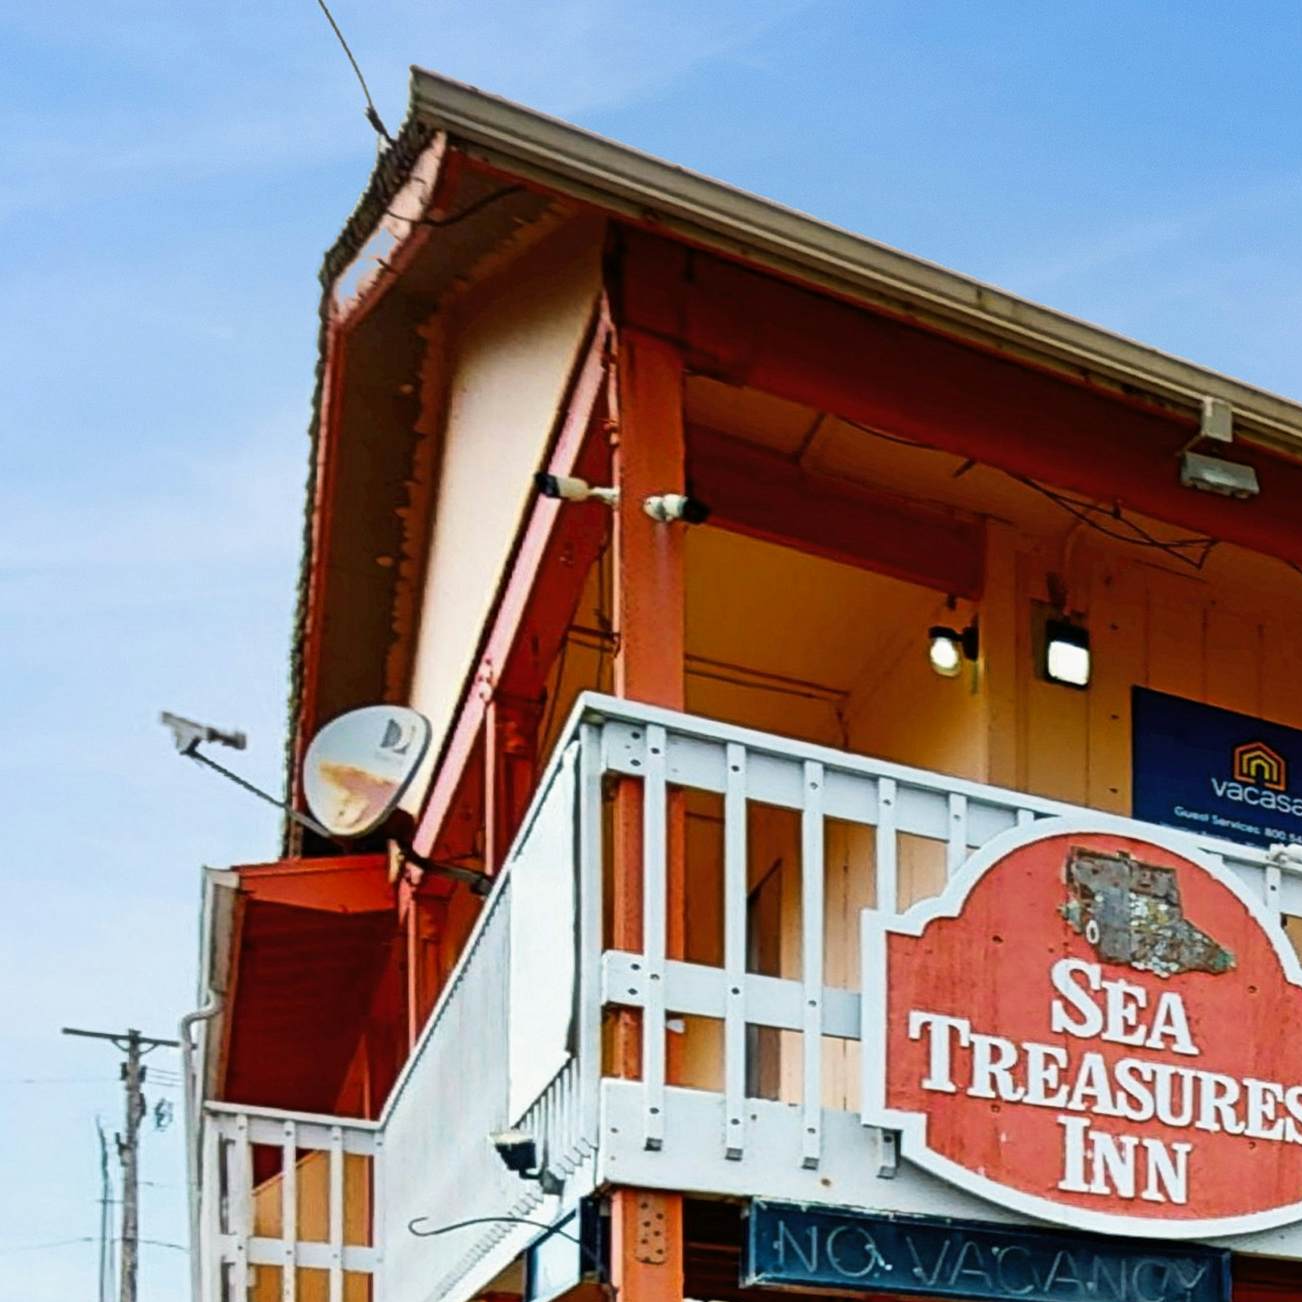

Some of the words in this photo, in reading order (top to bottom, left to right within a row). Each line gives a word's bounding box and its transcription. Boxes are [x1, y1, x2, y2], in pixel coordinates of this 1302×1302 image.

[1050, 957, 1199, 1054] SEA
[1057, 1115, 1192, 1205] INN
[774, 1220, 878, 1277] NO
